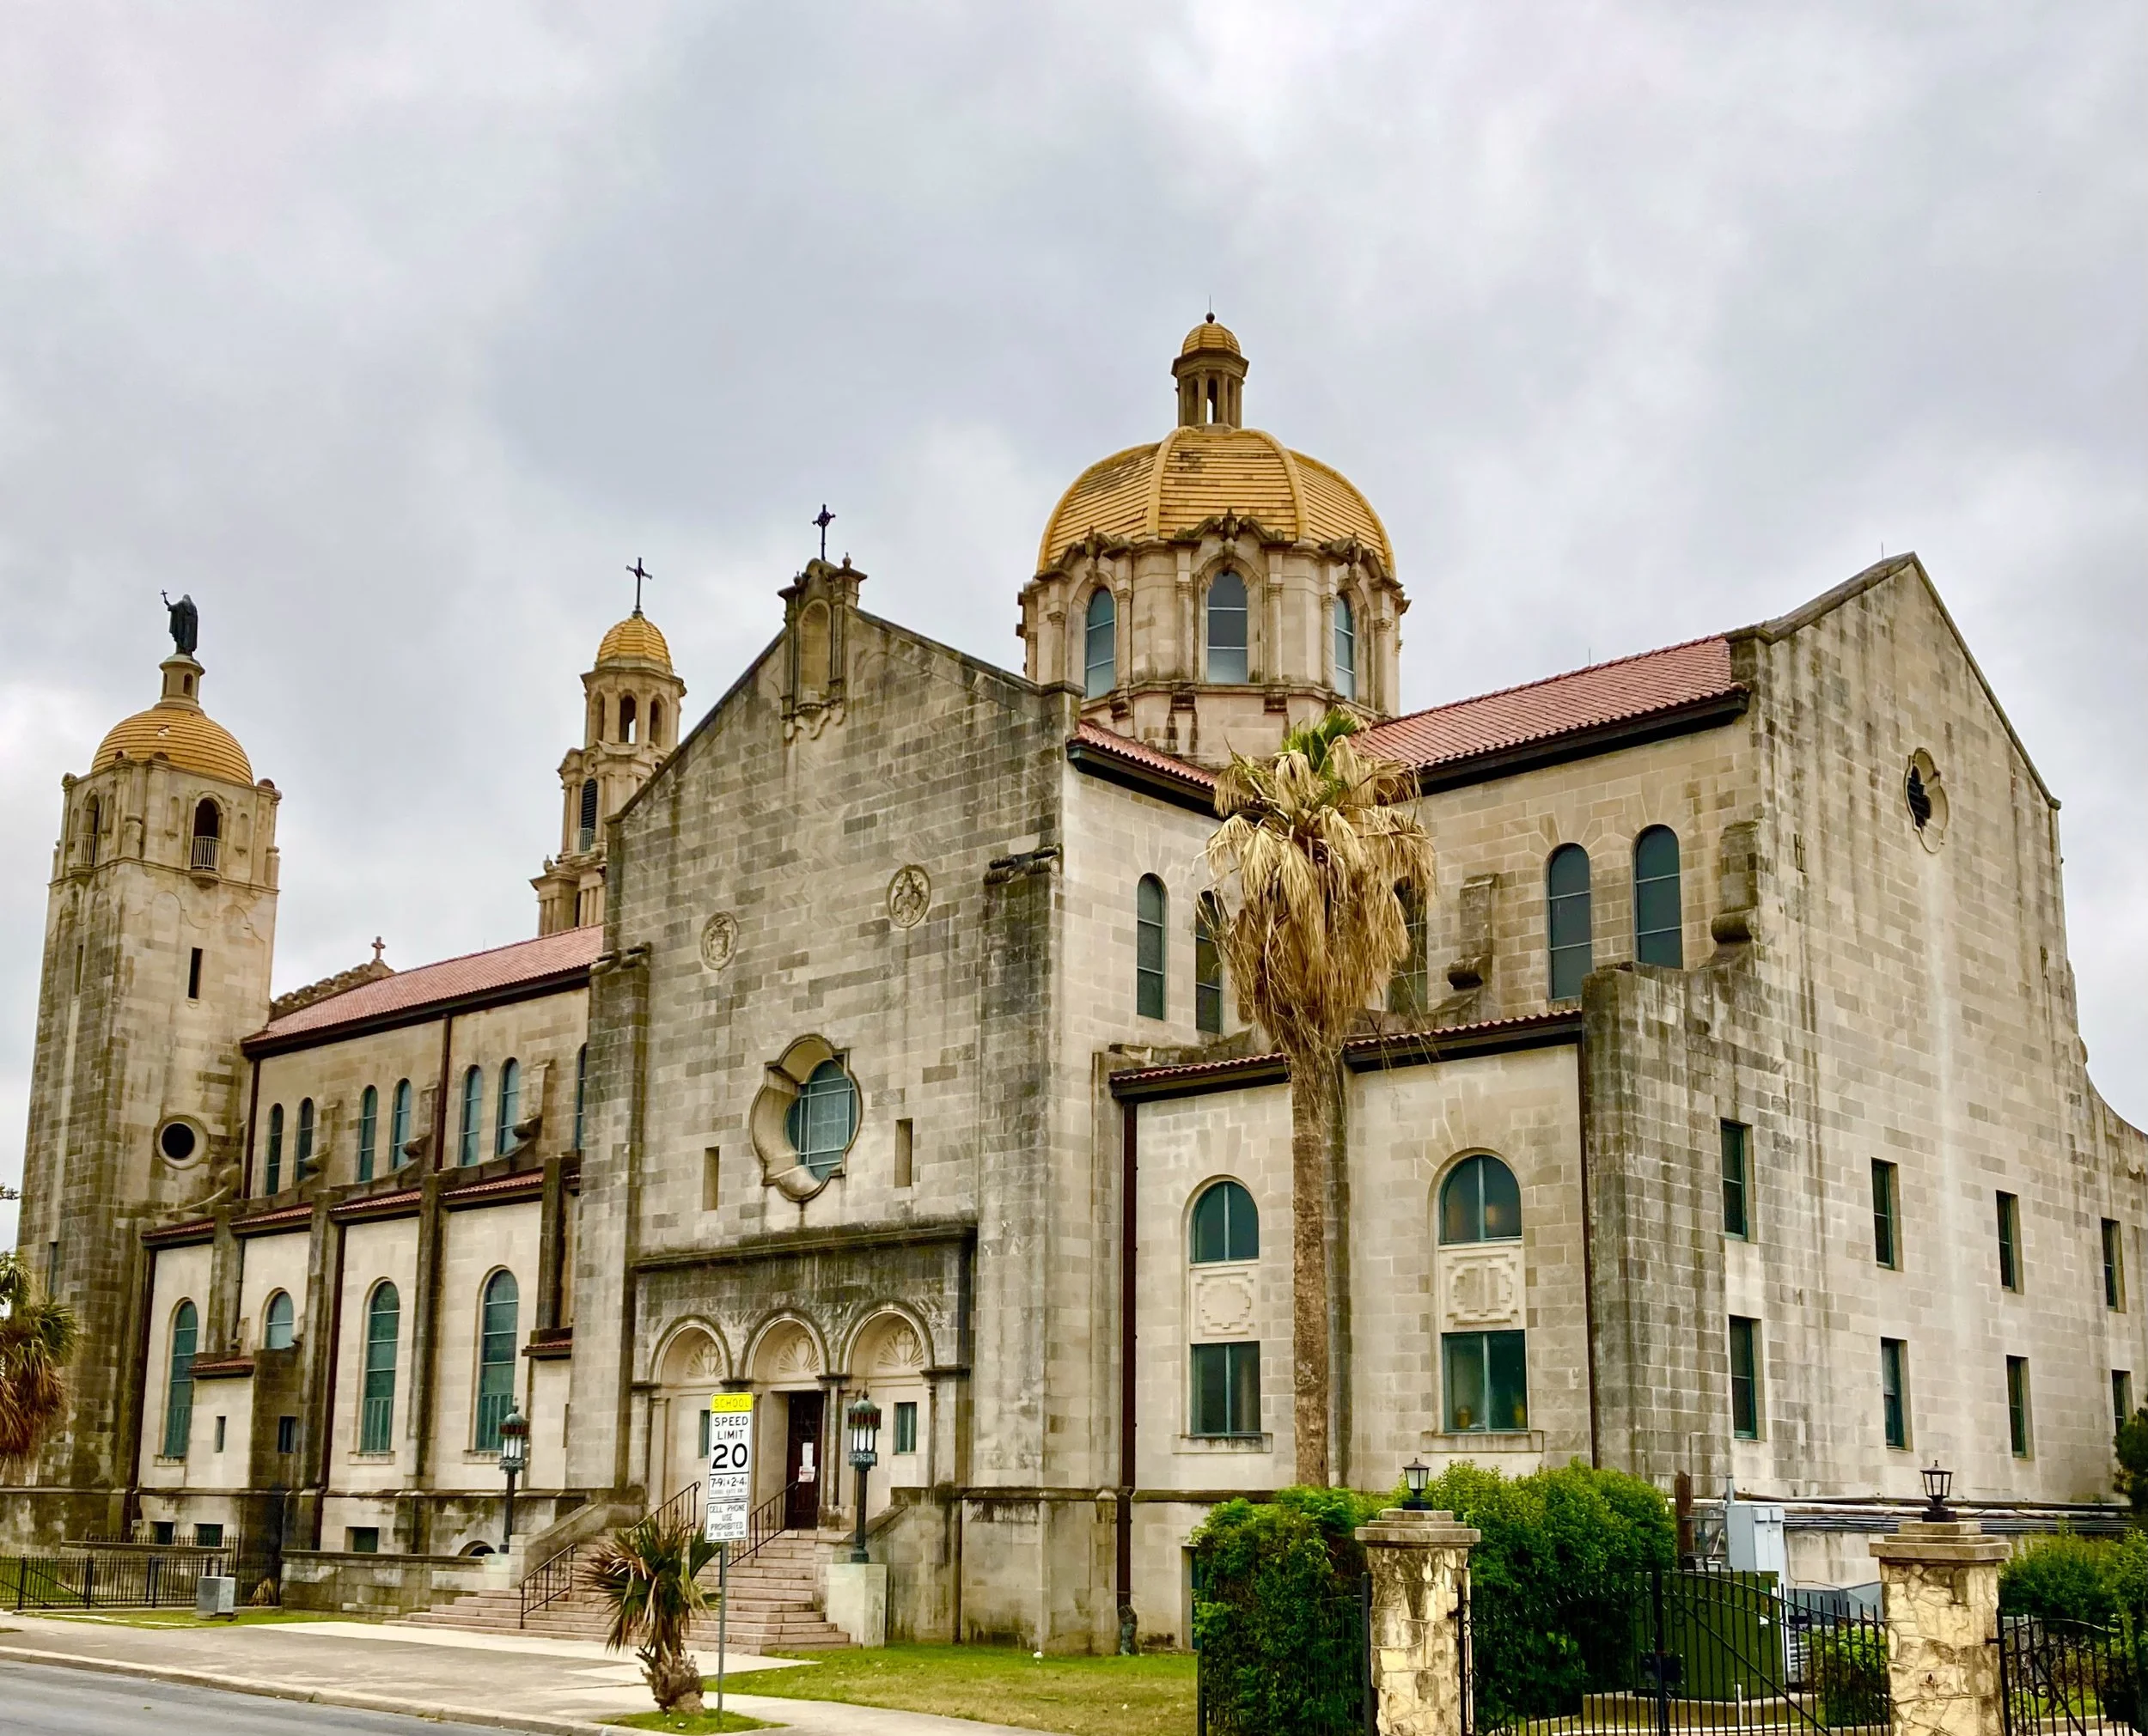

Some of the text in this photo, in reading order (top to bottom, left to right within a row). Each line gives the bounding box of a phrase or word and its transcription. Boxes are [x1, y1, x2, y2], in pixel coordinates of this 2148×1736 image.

[714, 1398, 749, 1409] SCHOOL
[714, 1416, 748, 1427] SPEED
[717, 1429, 744, 1441] LIMIT
[712, 1443, 748, 1469] 20
[711, 1522, 744, 1532] PROHIBITED
